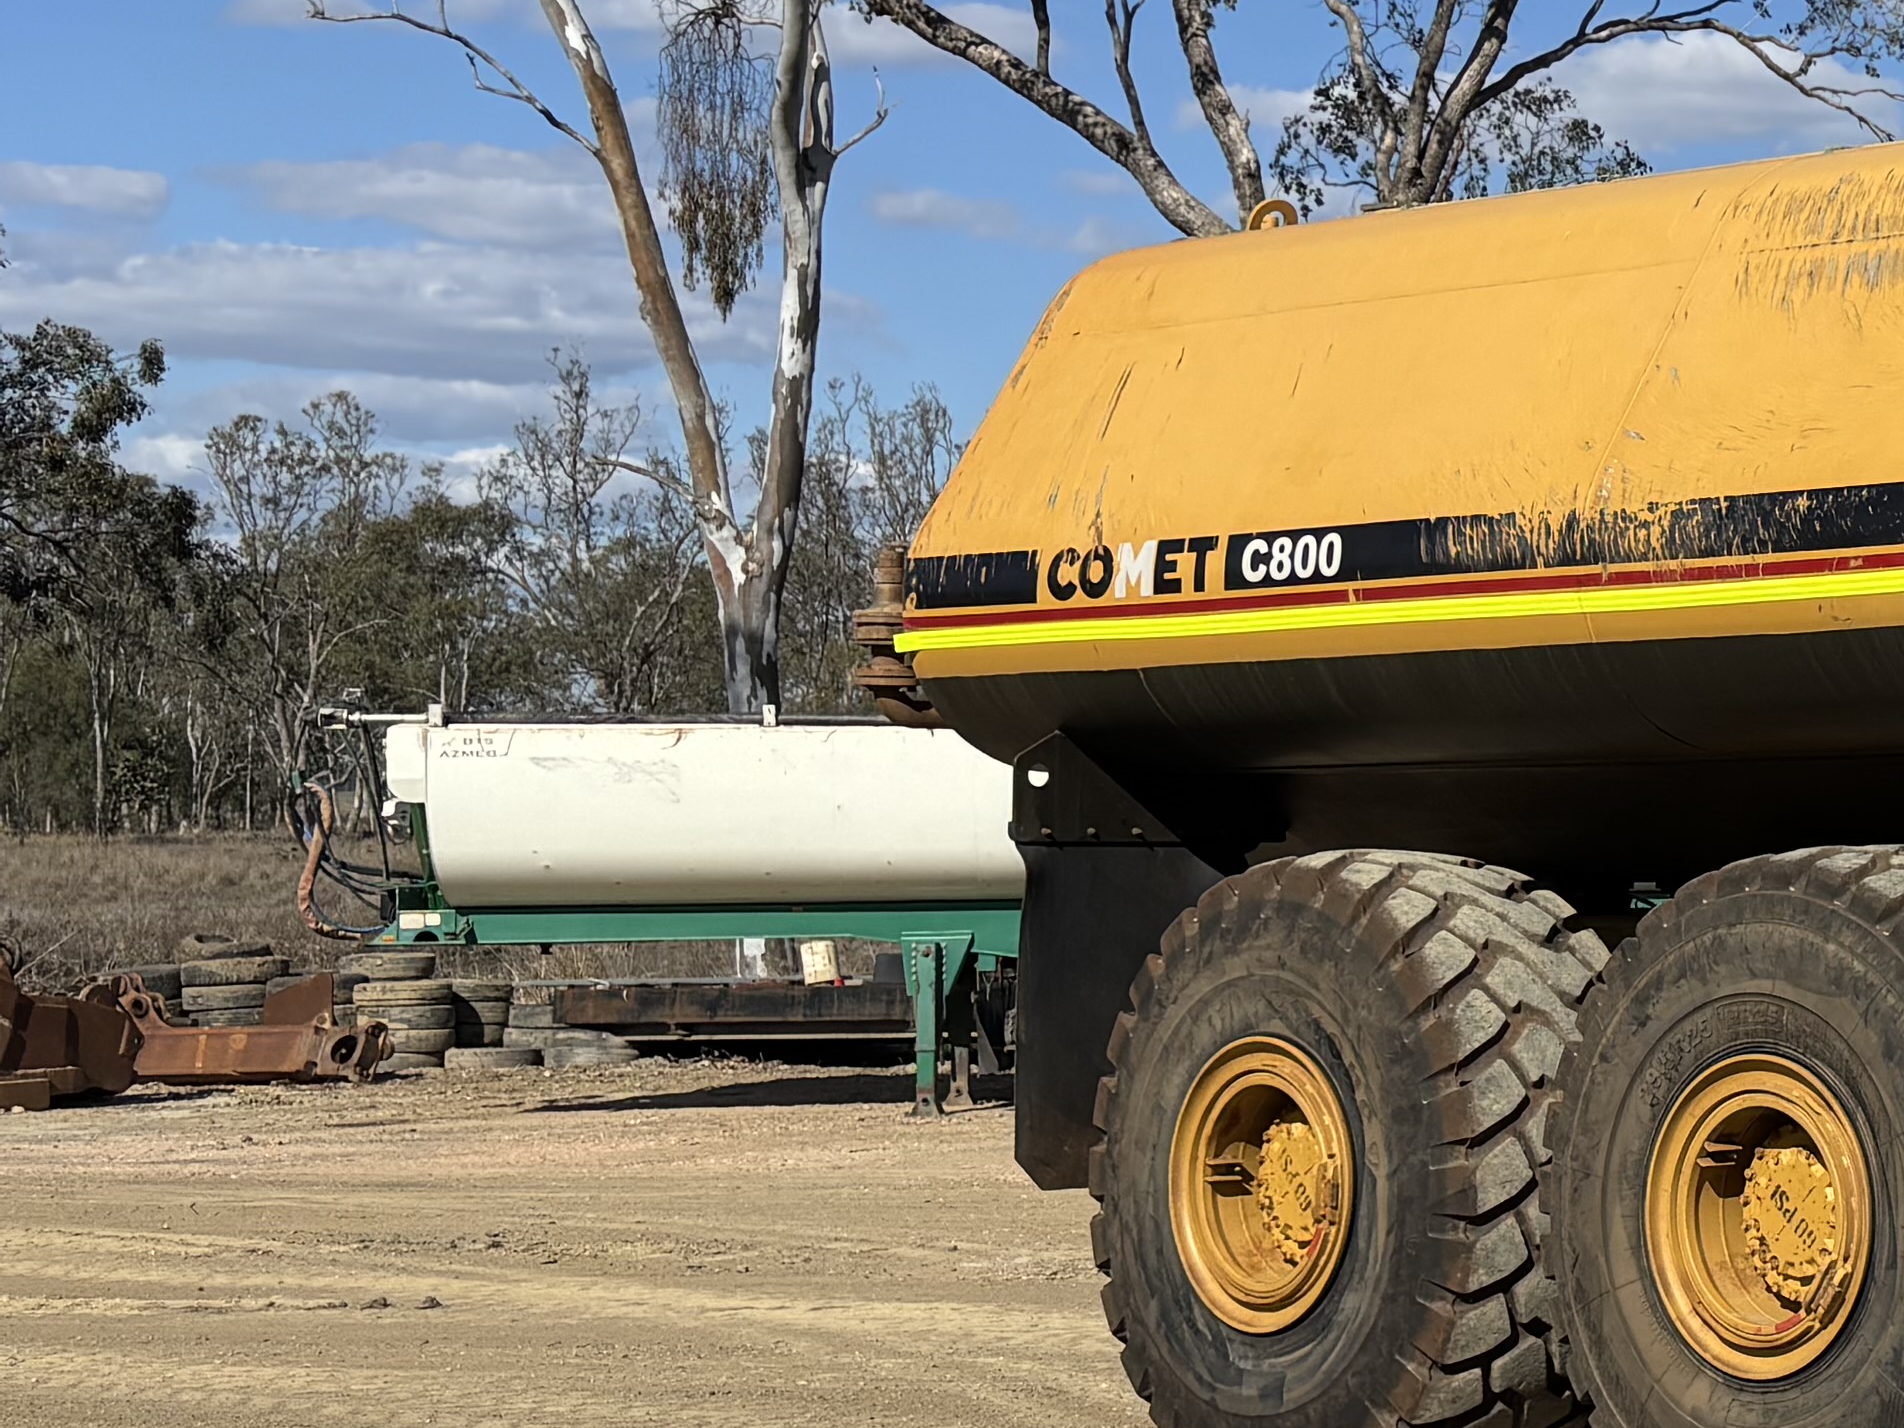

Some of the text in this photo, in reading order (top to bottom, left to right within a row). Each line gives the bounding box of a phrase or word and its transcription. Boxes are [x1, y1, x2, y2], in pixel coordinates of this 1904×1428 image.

[1047, 532, 1342, 601] COMET C800
[1770, 1183, 1798, 1224] PSI
